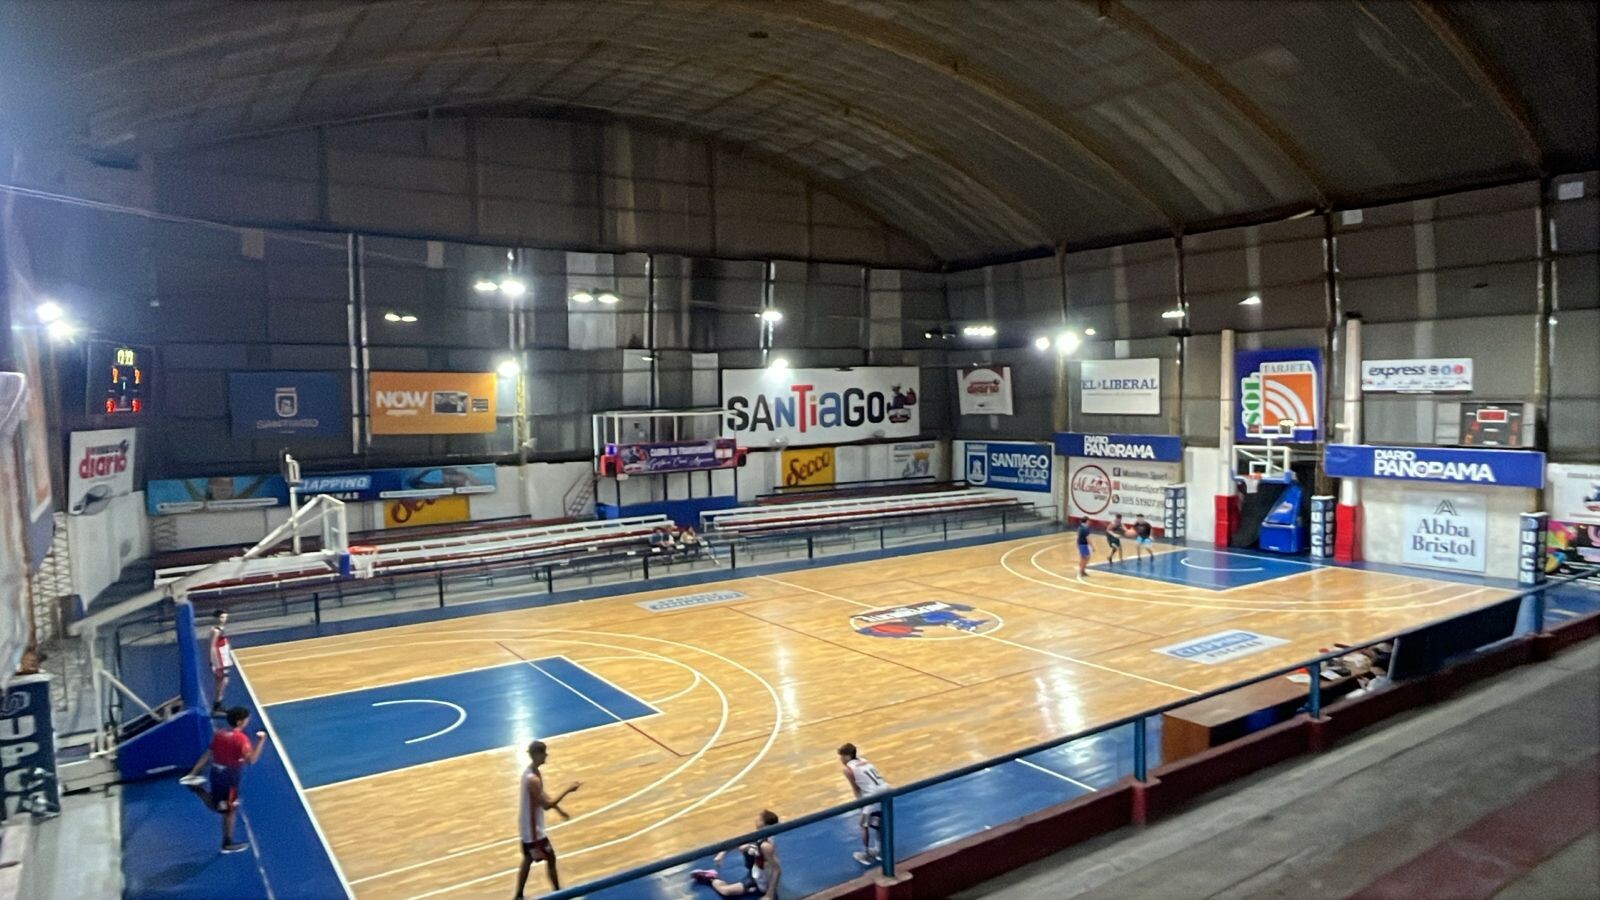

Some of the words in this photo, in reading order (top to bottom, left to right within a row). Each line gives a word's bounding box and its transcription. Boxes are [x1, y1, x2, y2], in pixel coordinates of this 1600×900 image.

[1264, 363, 1313, 374] TARJETA
[1368, 364, 1426, 379] express
[1082, 379, 1097, 390] EL
[1102, 378, 1158, 390] LIBERAL
[375, 390, 429, 408] NOW
[1083, 435, 1109, 444] DIARIO
[1083, 443, 1157, 459] PANORAMA
[1374, 449, 1416, 460] DIARIO
[79, 448, 127, 479] diario
[991, 452, 1049, 469] SANTIAGO
[1374, 459, 1497, 482] PANORAMA
[1416, 518, 1471, 538] Abba
[1411, 534, 1477, 557] Bristol
